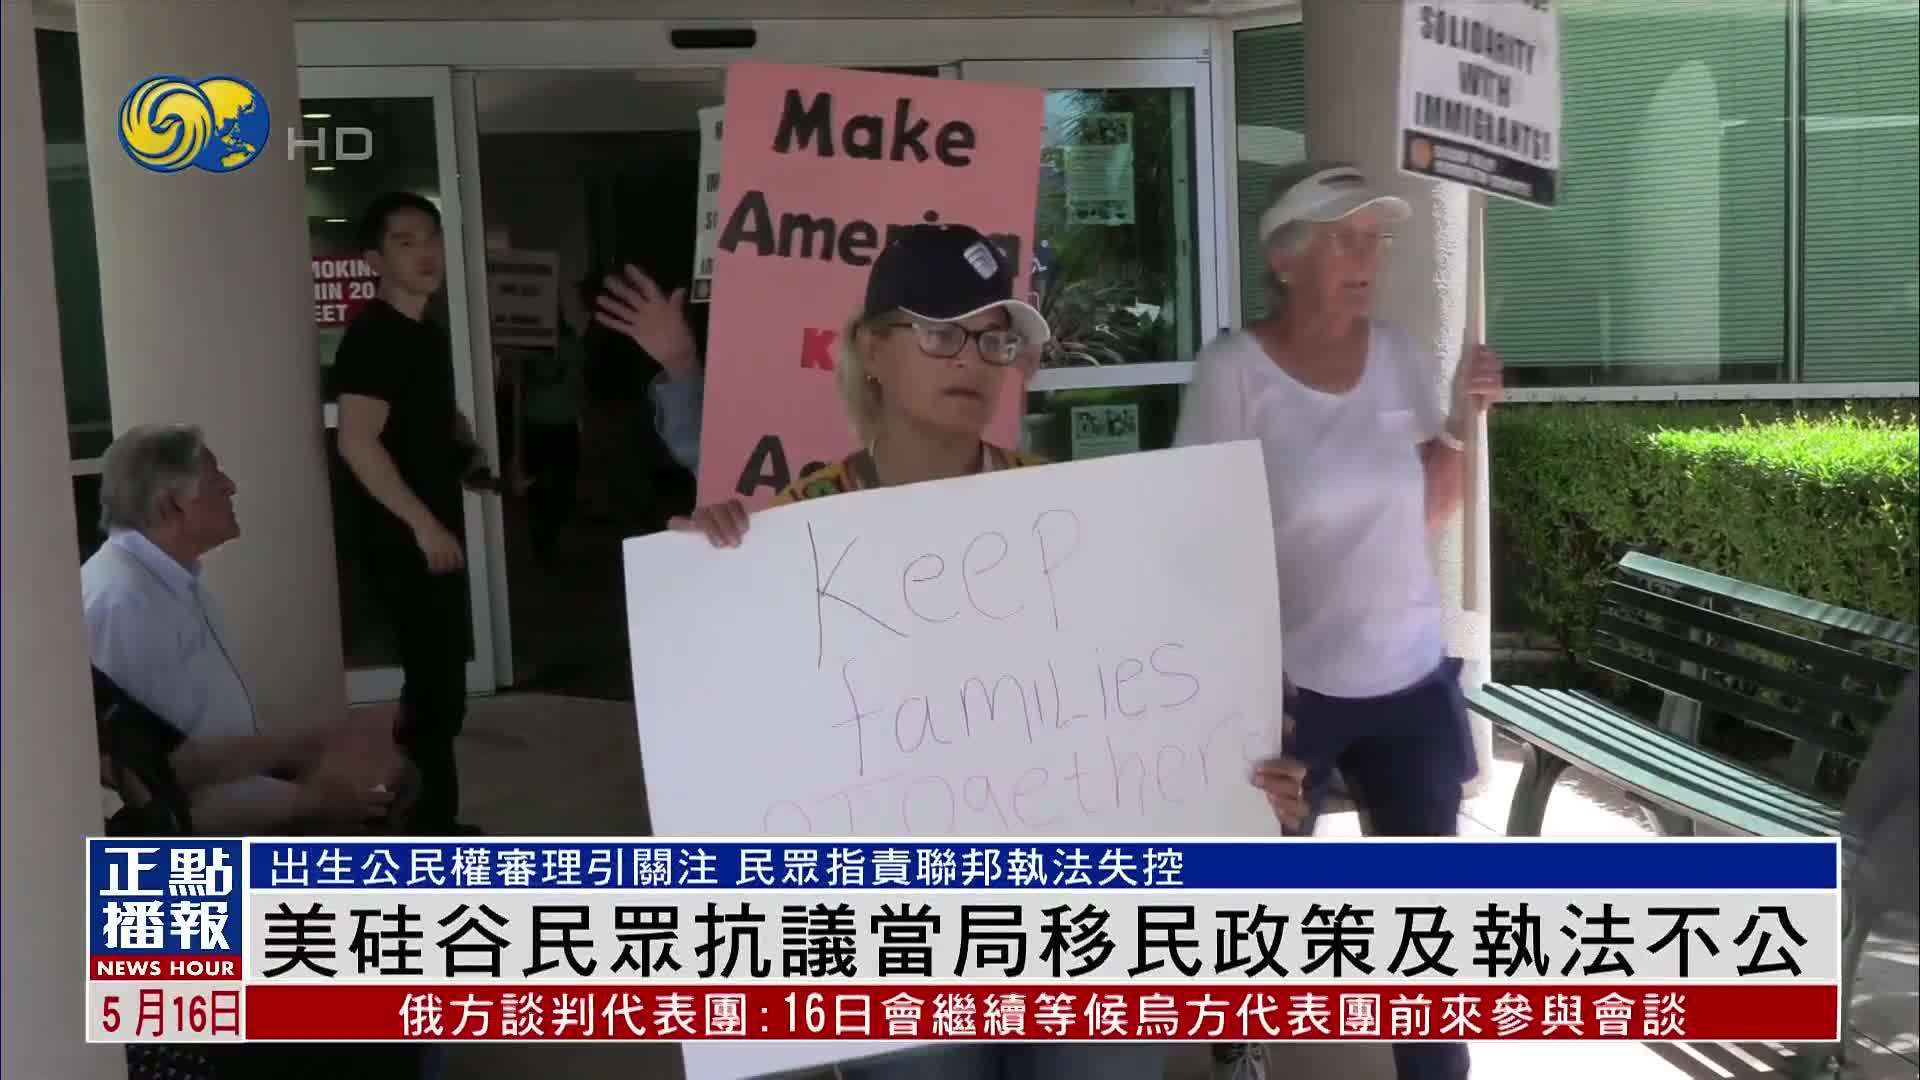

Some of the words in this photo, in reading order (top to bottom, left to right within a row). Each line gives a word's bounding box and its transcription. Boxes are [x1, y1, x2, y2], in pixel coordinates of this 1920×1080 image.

[1420, 5, 1537, 75] SOLIDARITY
[1458, 61, 1512, 108] WITH
[772, 89, 977, 167] Make
[348, 281, 376, 299] 20
